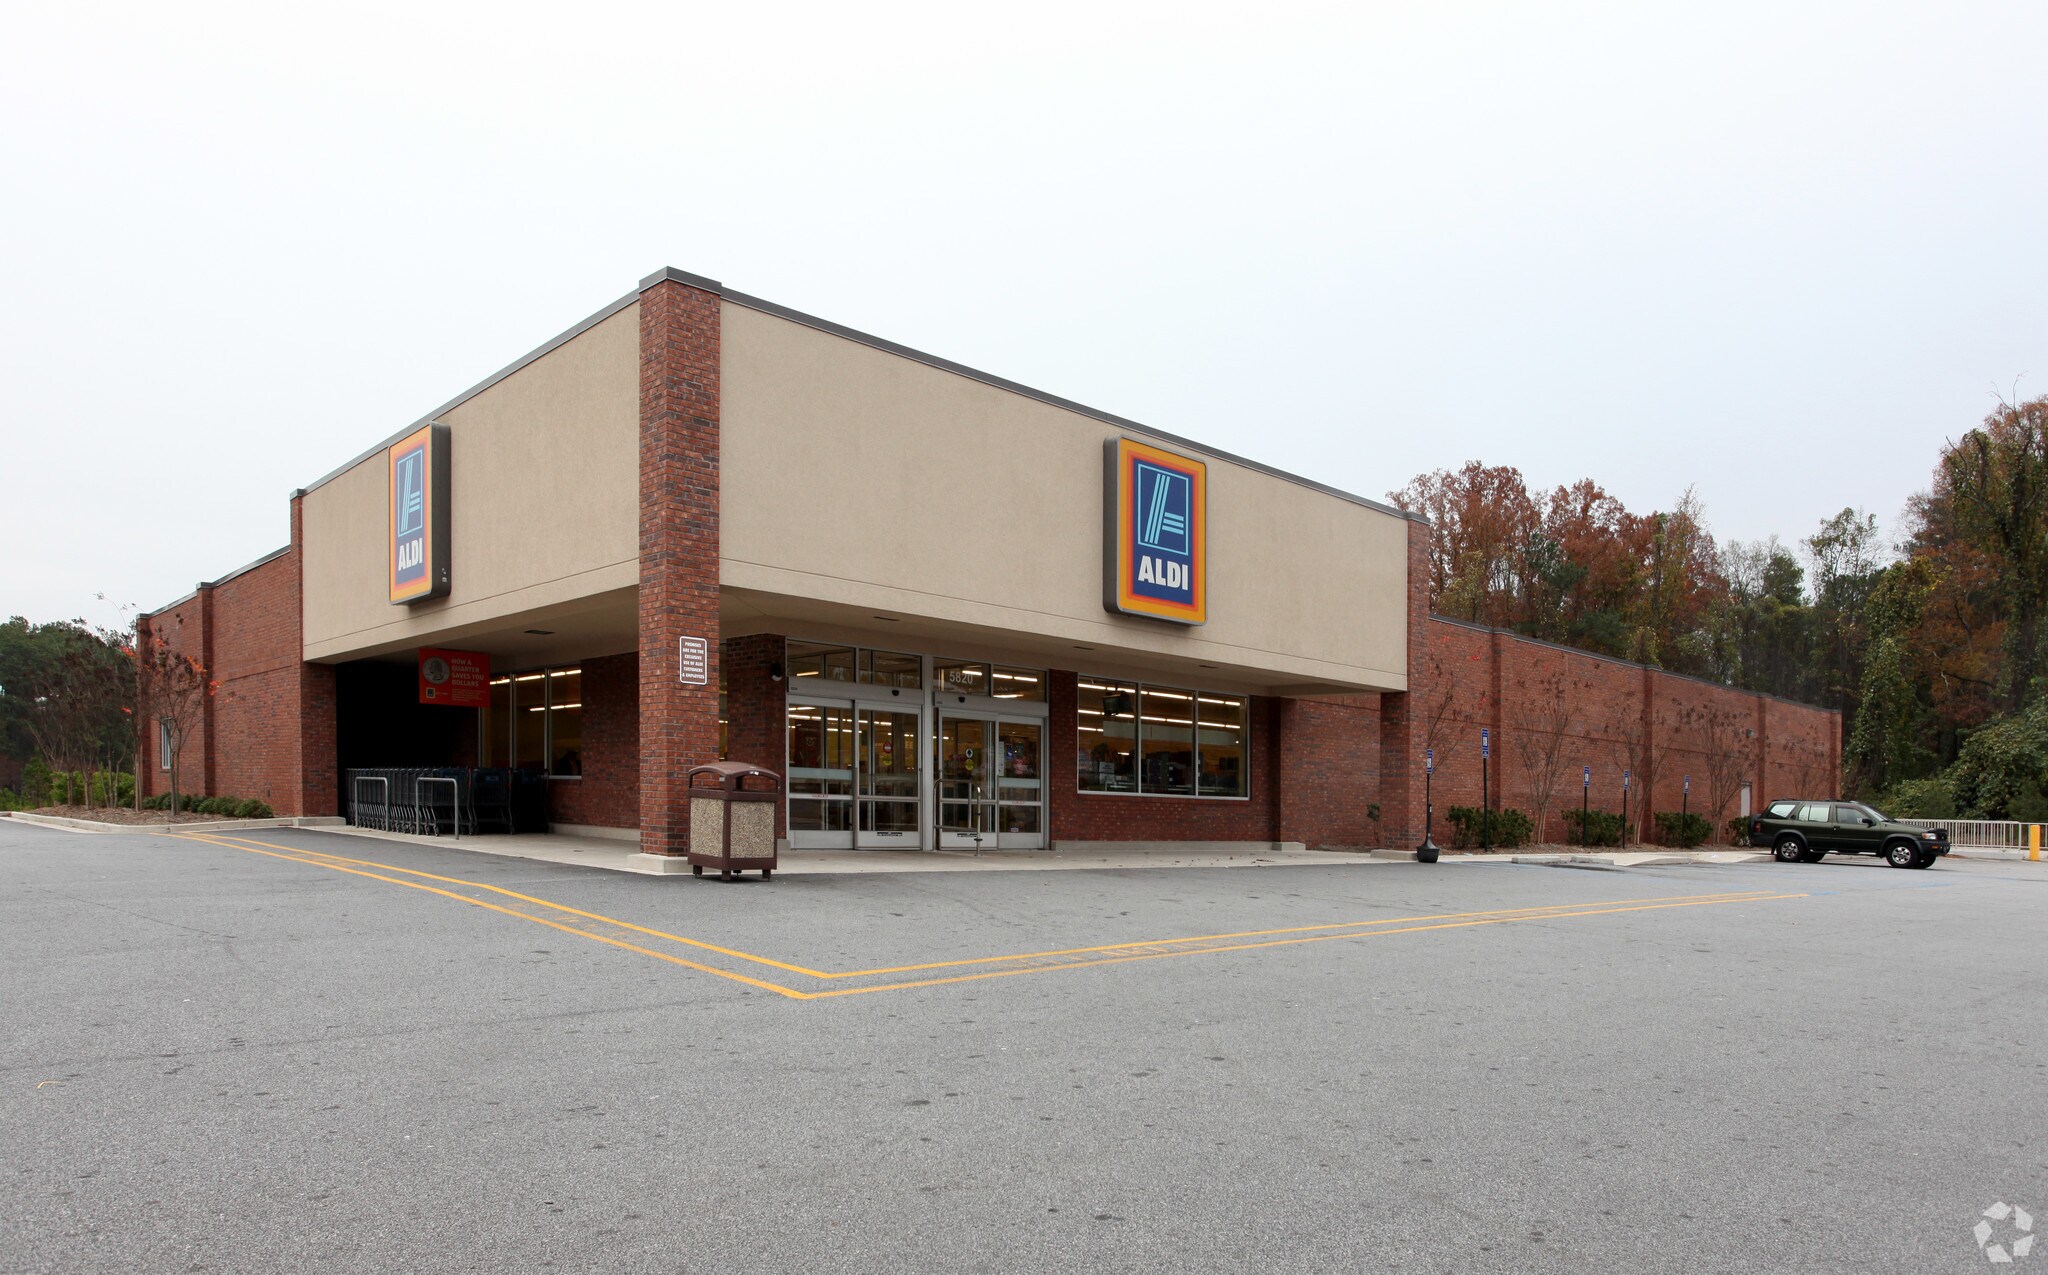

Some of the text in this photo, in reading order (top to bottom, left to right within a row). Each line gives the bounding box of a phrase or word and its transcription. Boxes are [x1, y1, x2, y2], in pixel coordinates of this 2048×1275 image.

[398, 537, 423, 571] ALDI
[1138, 555, 1189, 591] ALDI
[451, 665, 480, 673] QUARTER
[949, 671, 973, 685] 5820
